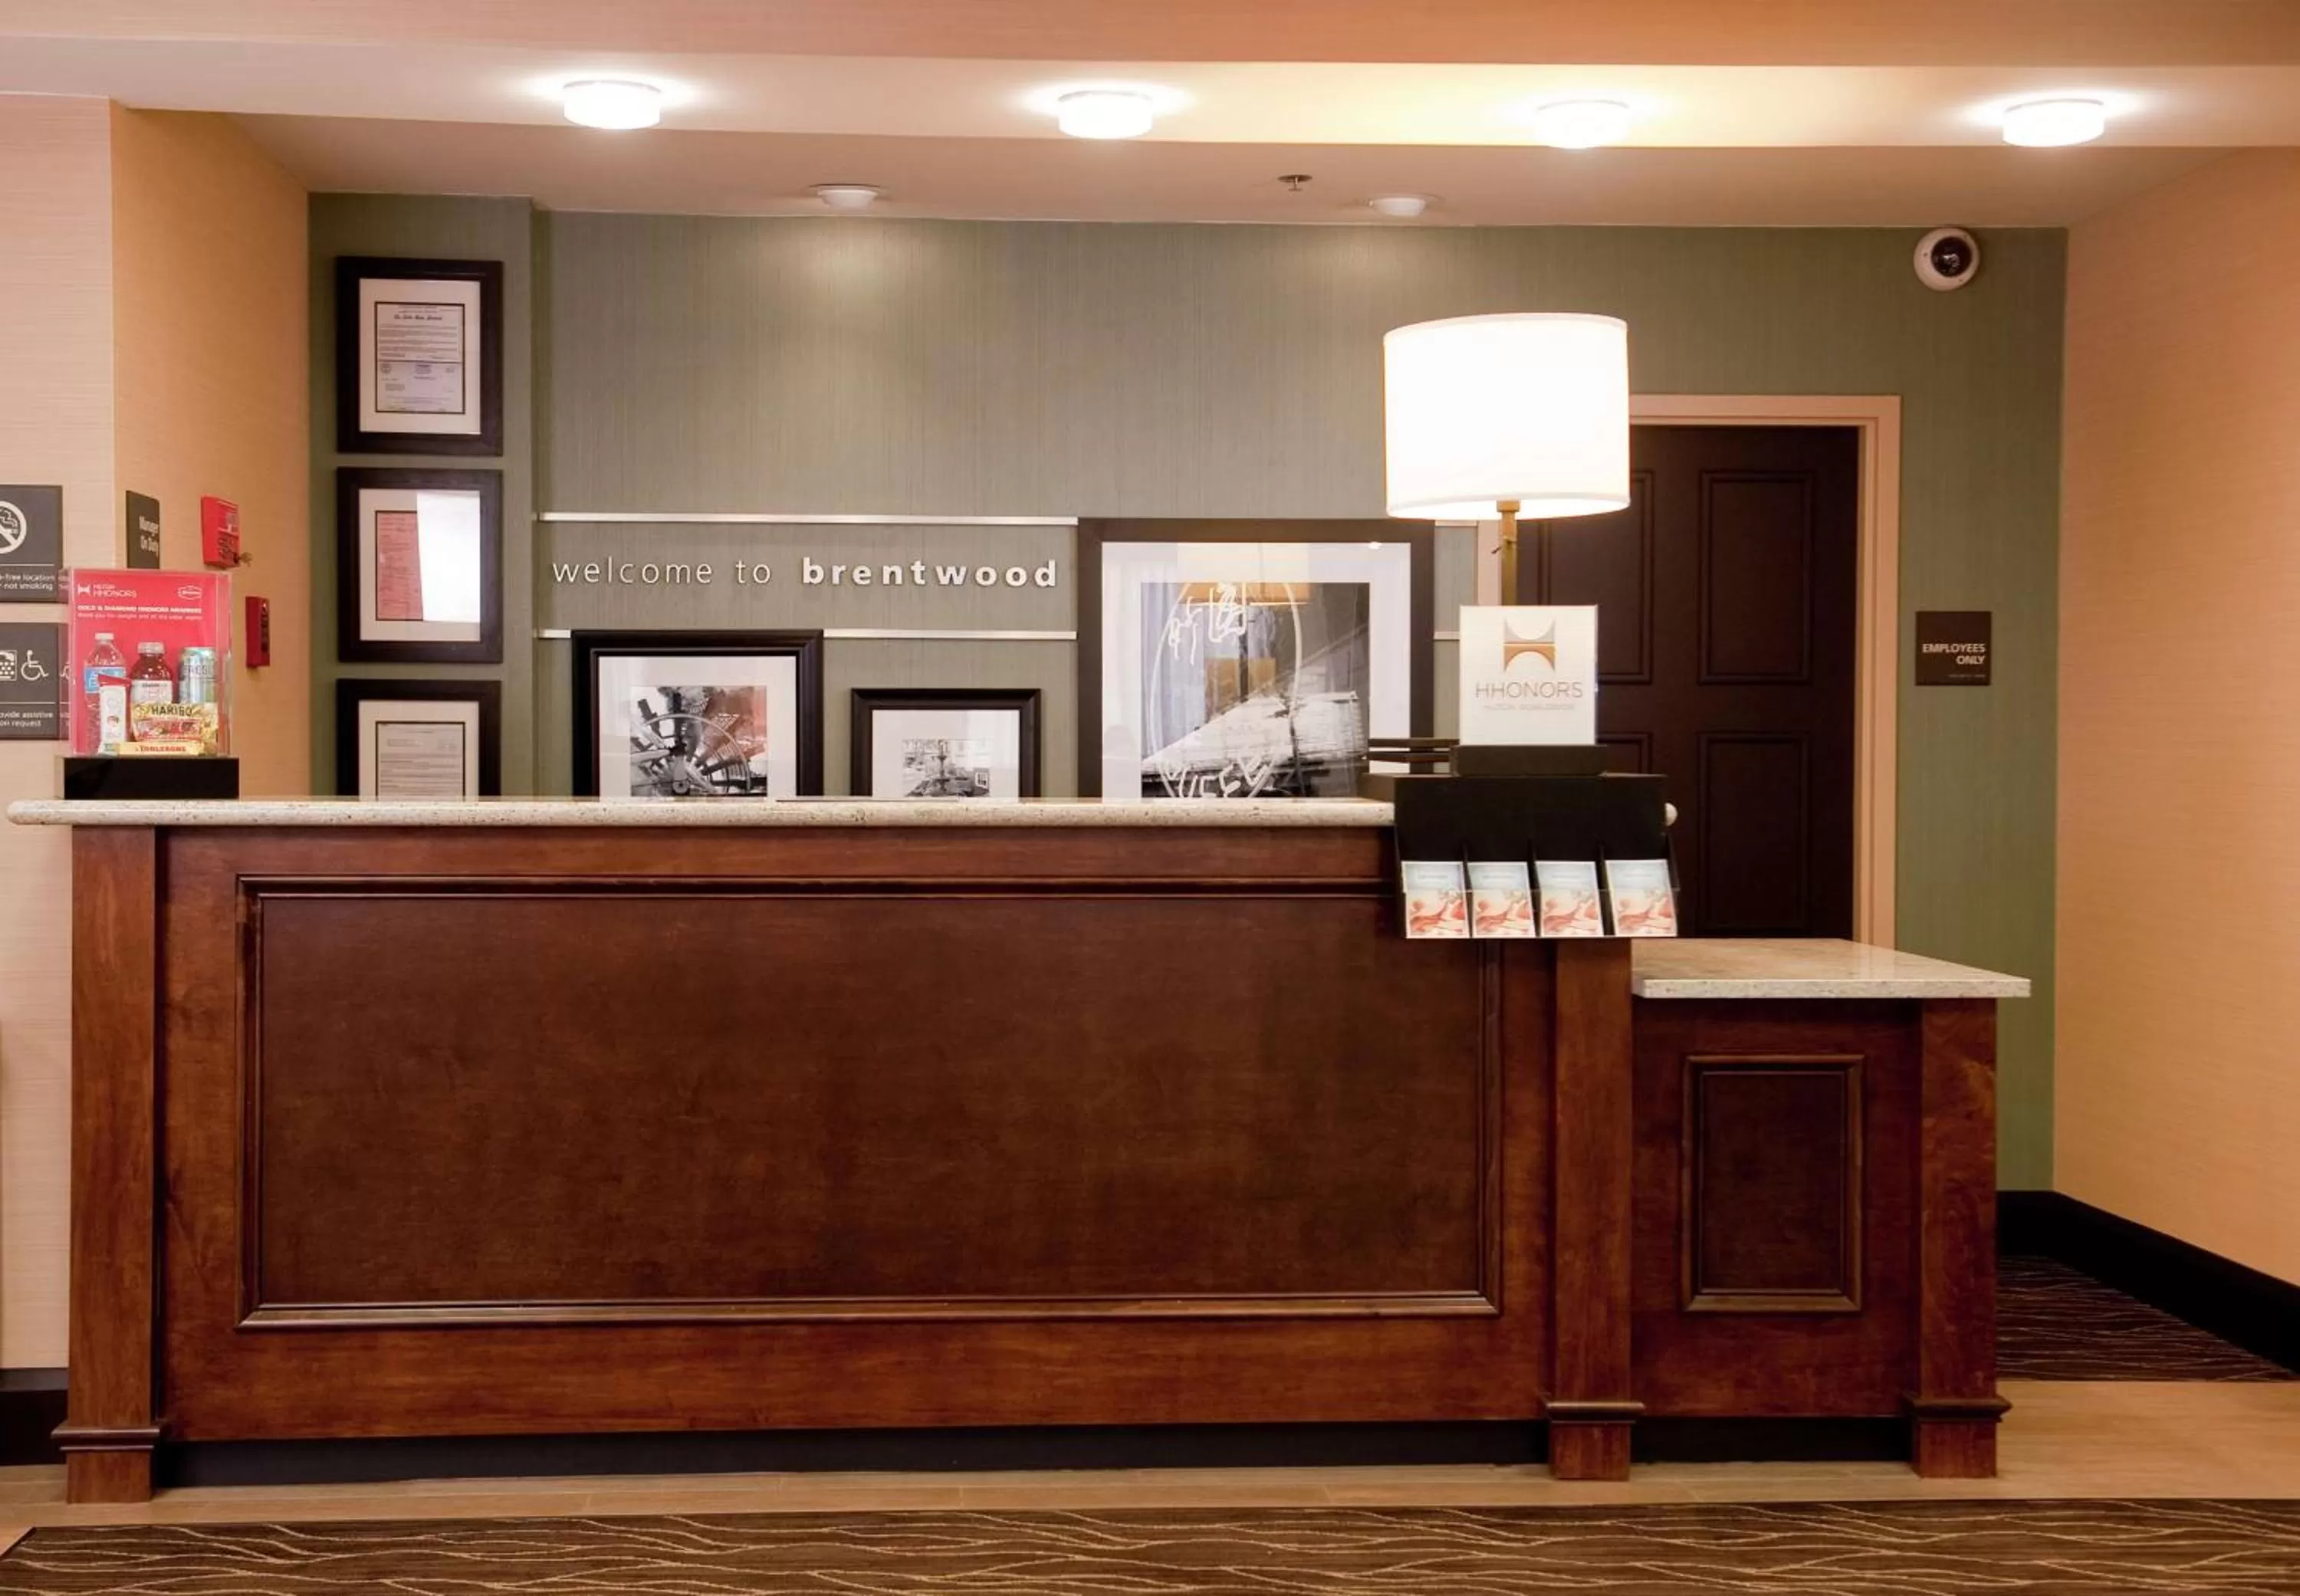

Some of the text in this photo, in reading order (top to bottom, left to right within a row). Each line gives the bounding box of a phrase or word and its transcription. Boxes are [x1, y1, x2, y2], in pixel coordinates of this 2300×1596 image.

[22, 573, 55, 581] location
[553, 556, 1058, 588] welcome to brentwood
[20, 583, 53, 592] smoking
[1922, 643, 1986, 653] EMPLOYEES
[1956, 655, 1986, 665] ONLY
[1475, 681, 1584, 699] HHONORS
[151, 704, 192, 717] HARIBO
